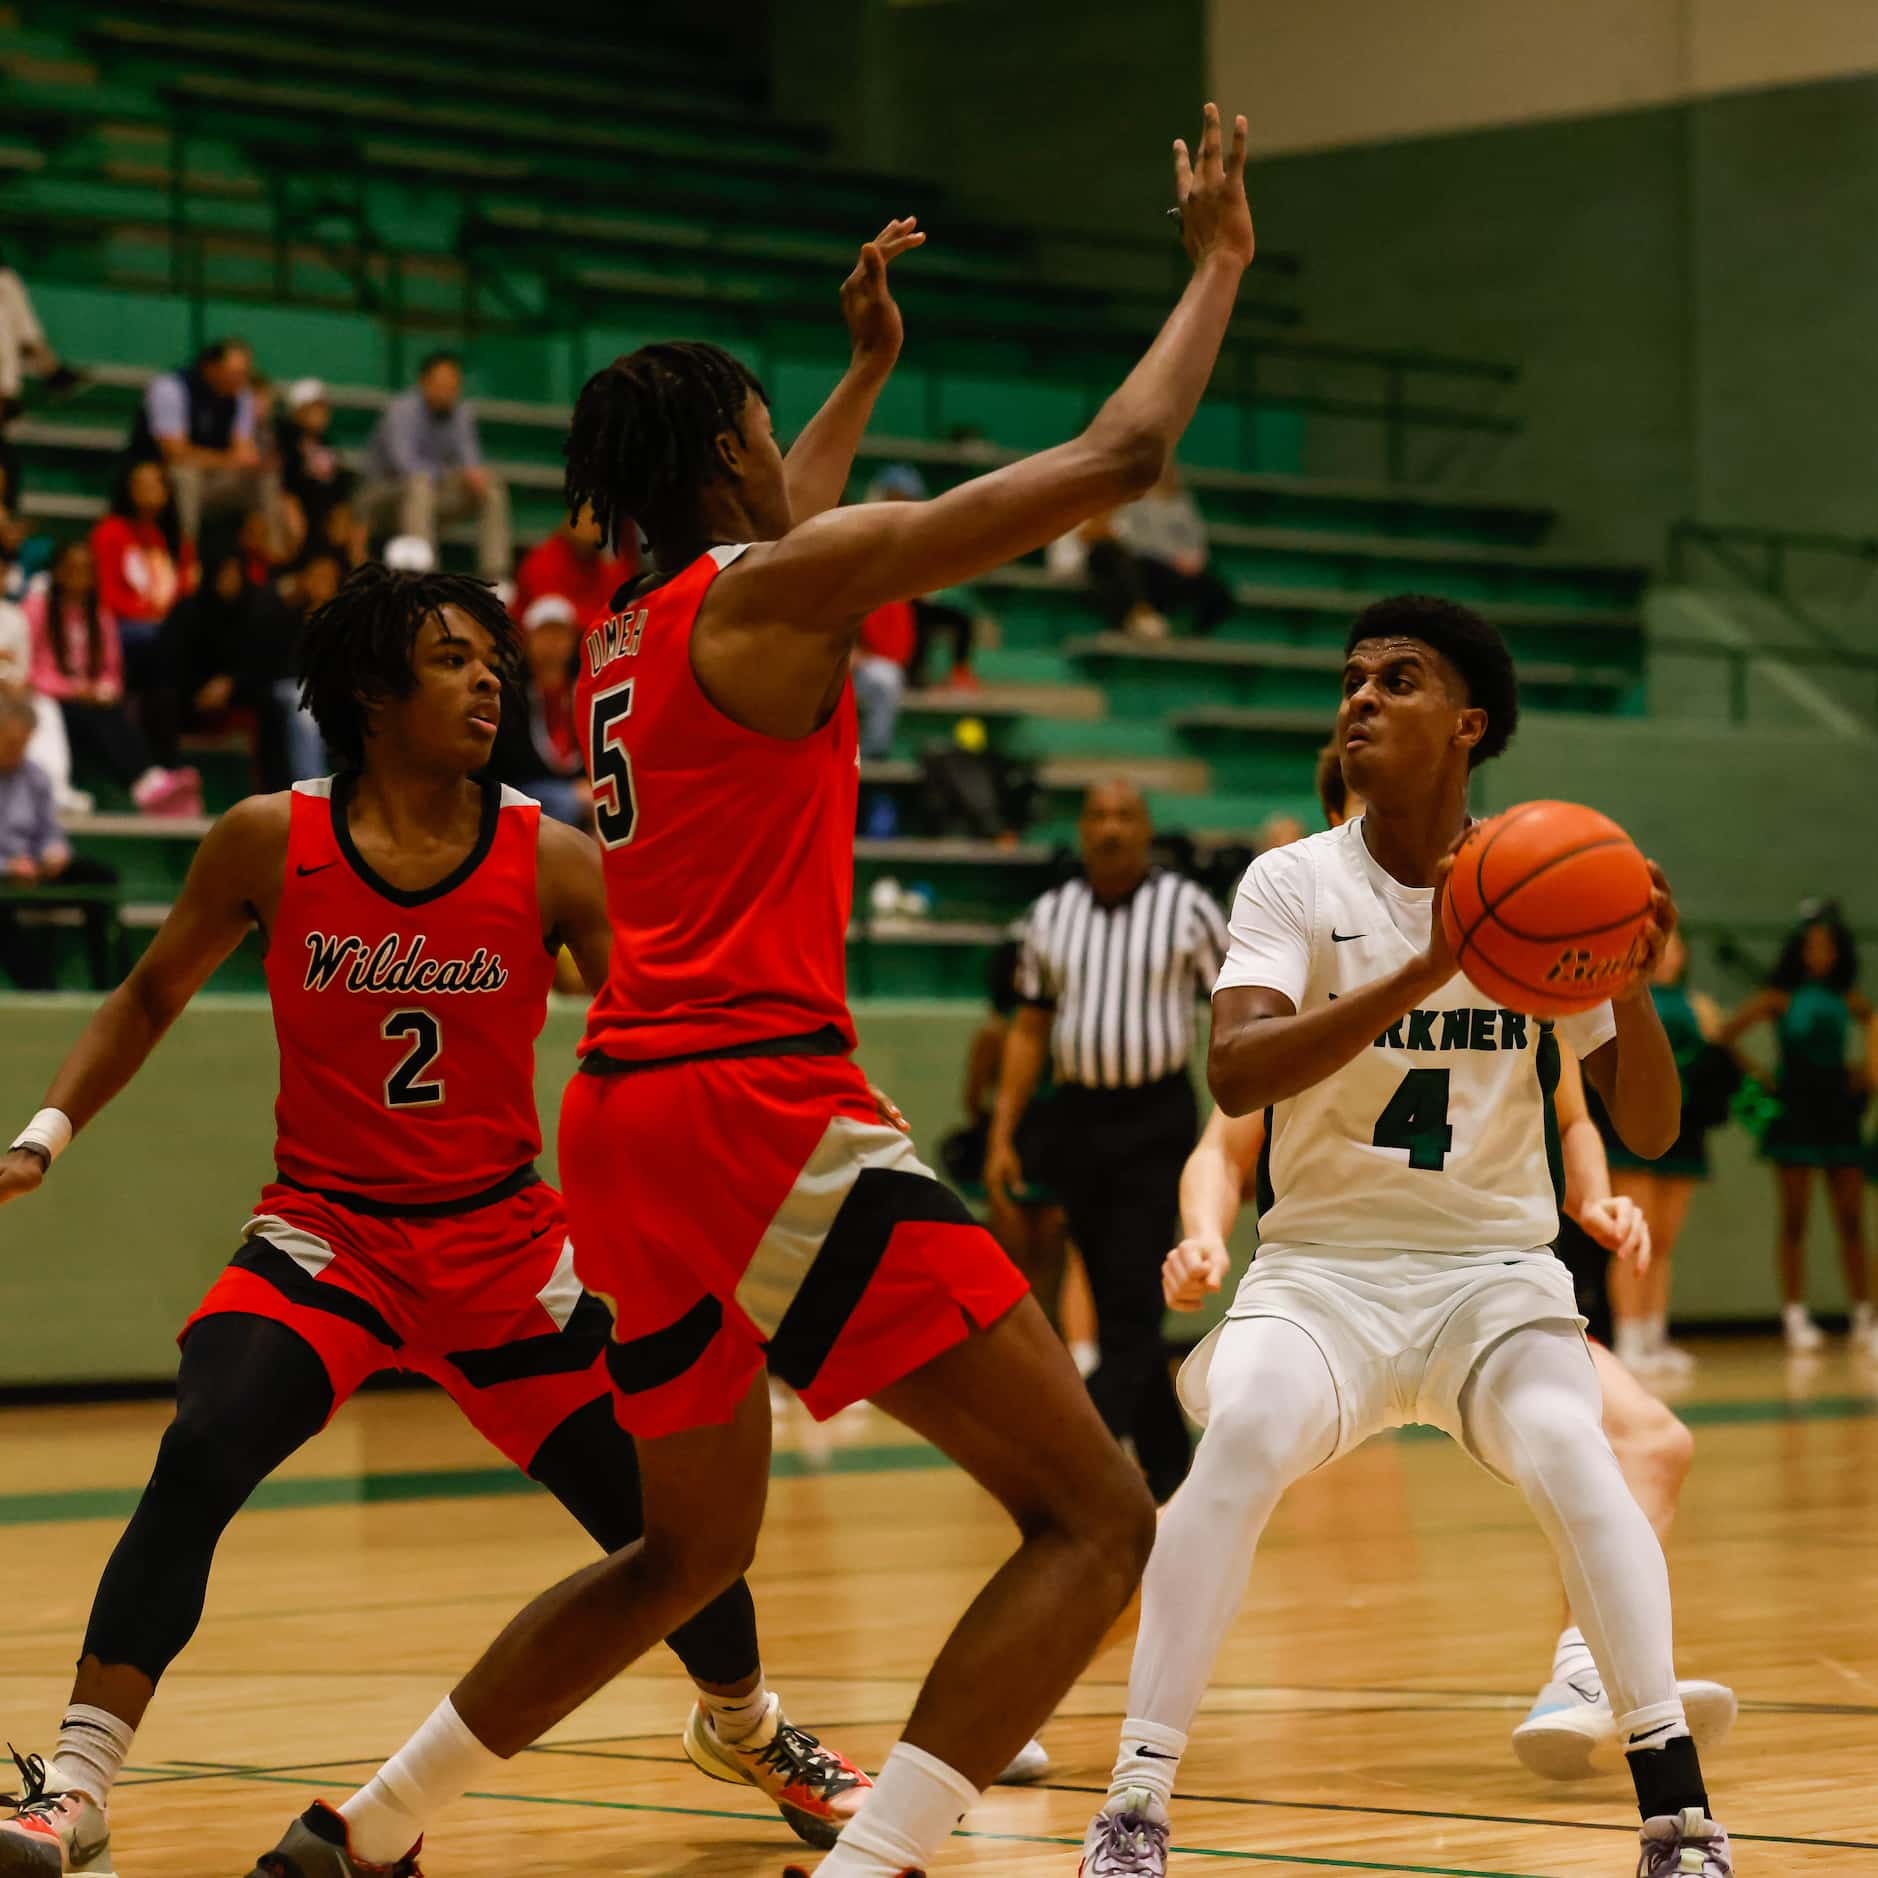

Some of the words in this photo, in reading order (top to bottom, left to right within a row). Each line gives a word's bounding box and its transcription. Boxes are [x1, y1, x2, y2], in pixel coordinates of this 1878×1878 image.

[586, 609, 648, 677] UMEH
[589, 677, 639, 850] 5
[304, 931, 508, 993] Wildcats
[380, 1007, 445, 1109] 2
[1328, 992, 1528, 1051] RKNER
[1372, 1068, 1453, 1171] 4
